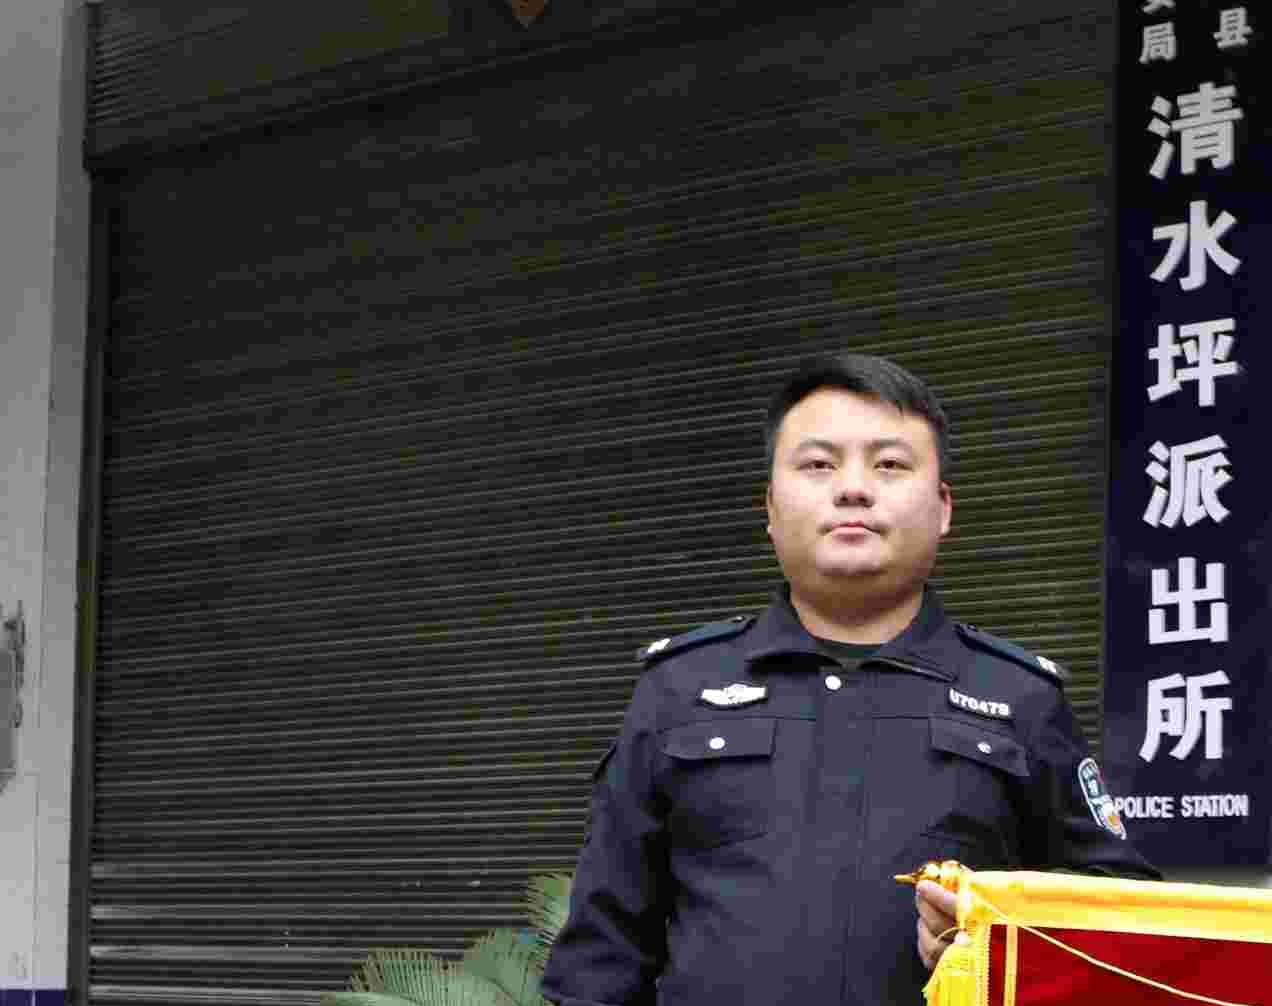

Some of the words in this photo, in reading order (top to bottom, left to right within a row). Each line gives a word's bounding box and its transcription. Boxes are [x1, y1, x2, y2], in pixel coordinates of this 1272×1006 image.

[1139, 82, 1243, 762] 清水坪派出所
[1113, 796, 1175, 818] POLICE
[1180, 795, 1249, 818] STATION
